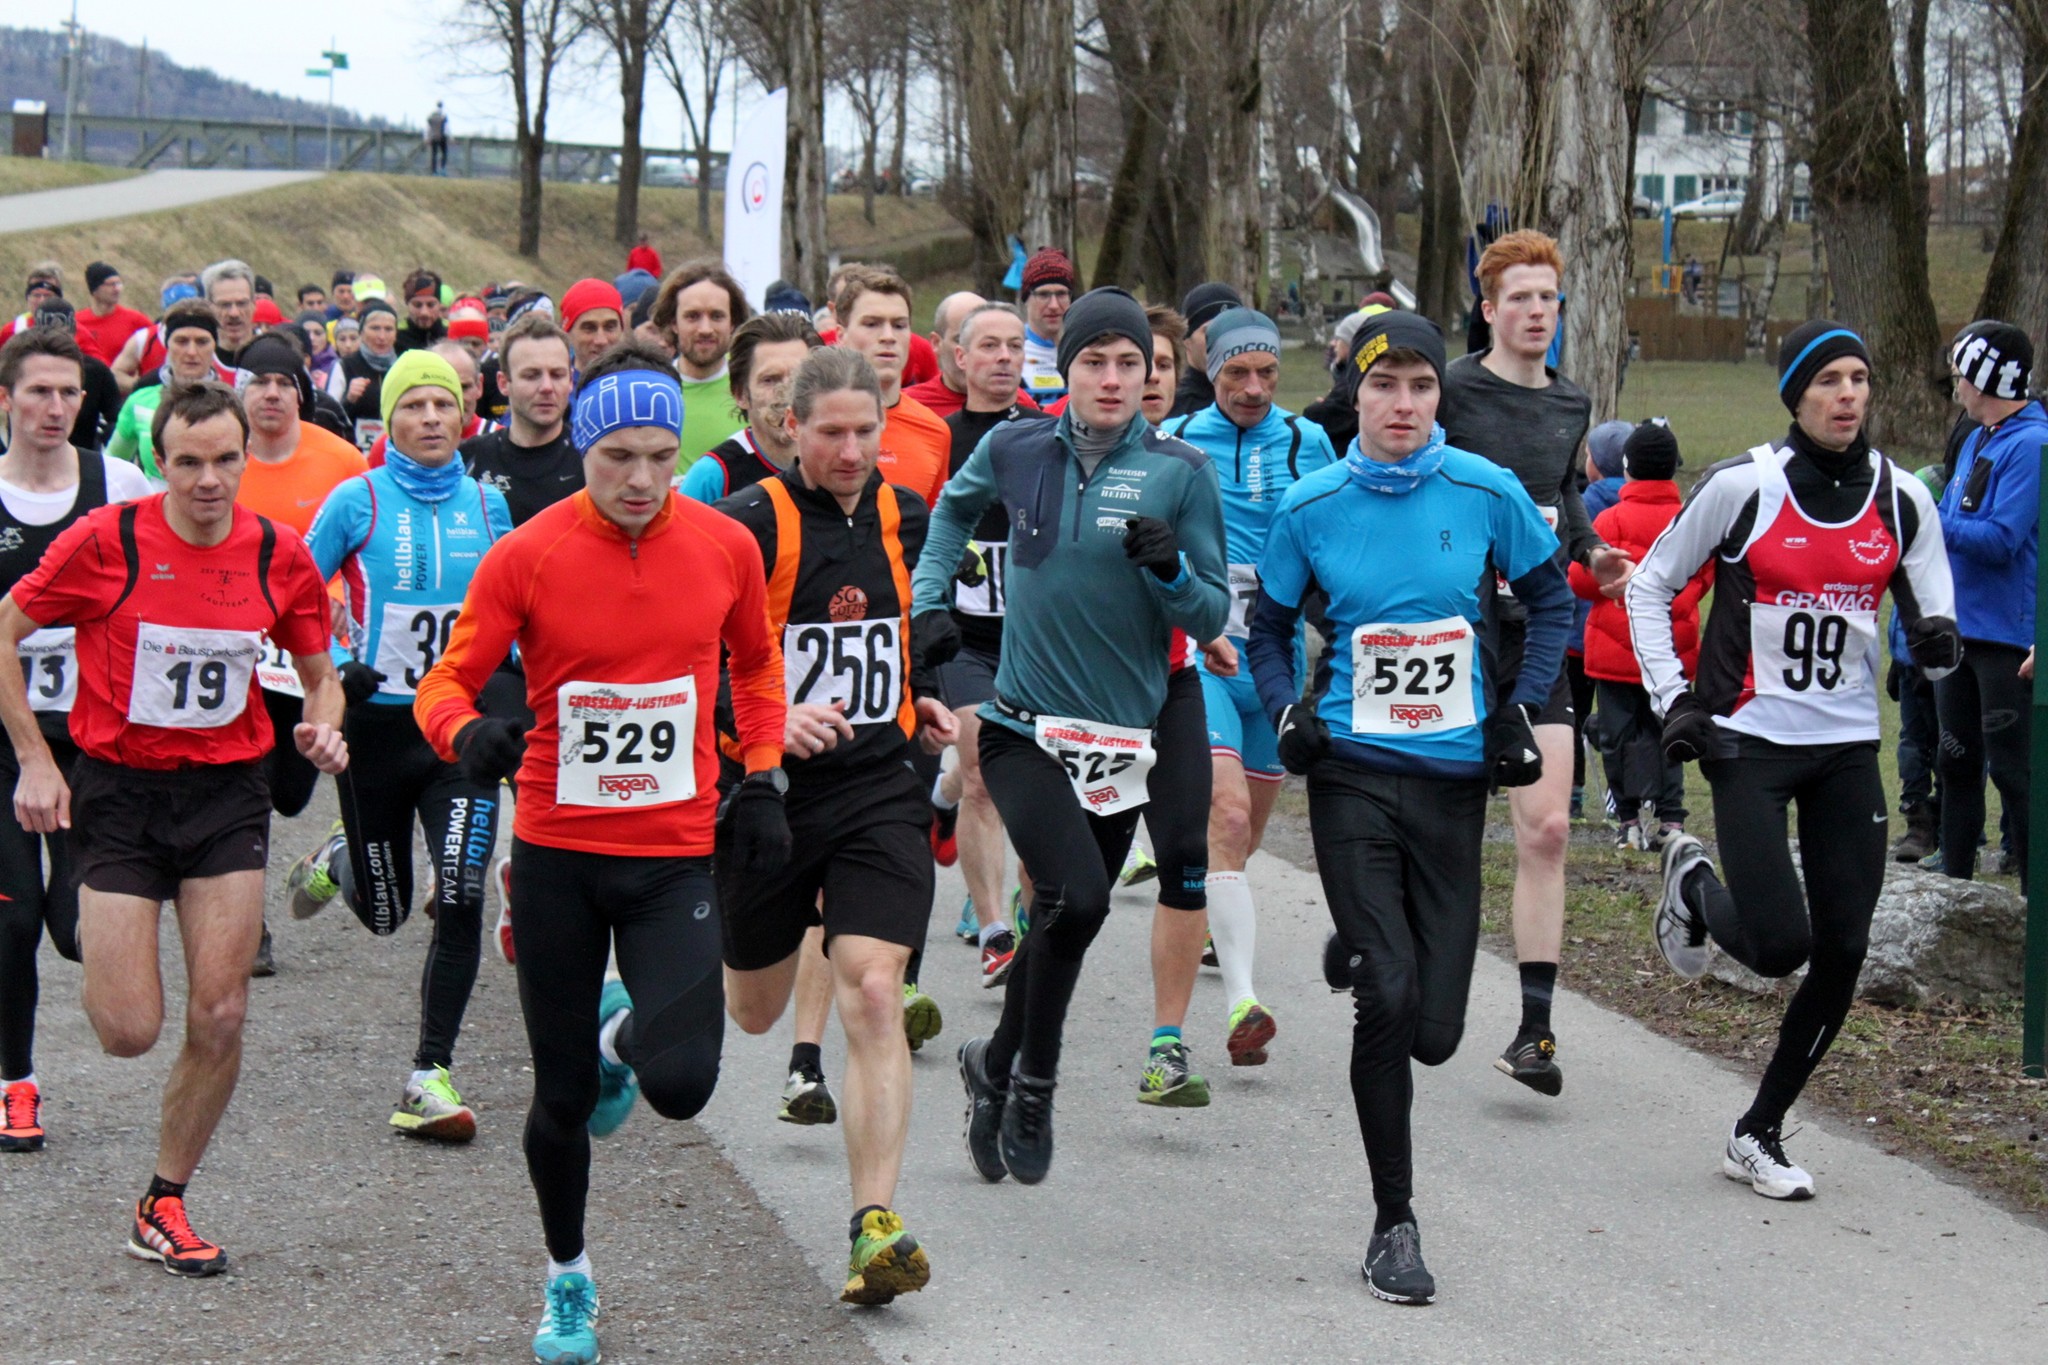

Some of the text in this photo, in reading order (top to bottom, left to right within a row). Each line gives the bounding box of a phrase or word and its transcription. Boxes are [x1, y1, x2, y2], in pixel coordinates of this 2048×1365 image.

[1101, 490, 1140, 500] HEIDEN
[834, 586, 860, 605] SG
[1775, 590, 1875, 611] GRAVAG
[1823, 582, 1859, 593] erdgas
[142, 640, 163, 653] Die
[793, 623, 893, 720] 256
[1374, 653, 1455, 695] 523
[166, 661, 227, 710] 19
[1390, 704, 1443, 729] hagen
[583, 720, 676, 765] 529
[598, 773, 660, 801] hagen
[366, 842, 391, 936] ellblau.com
